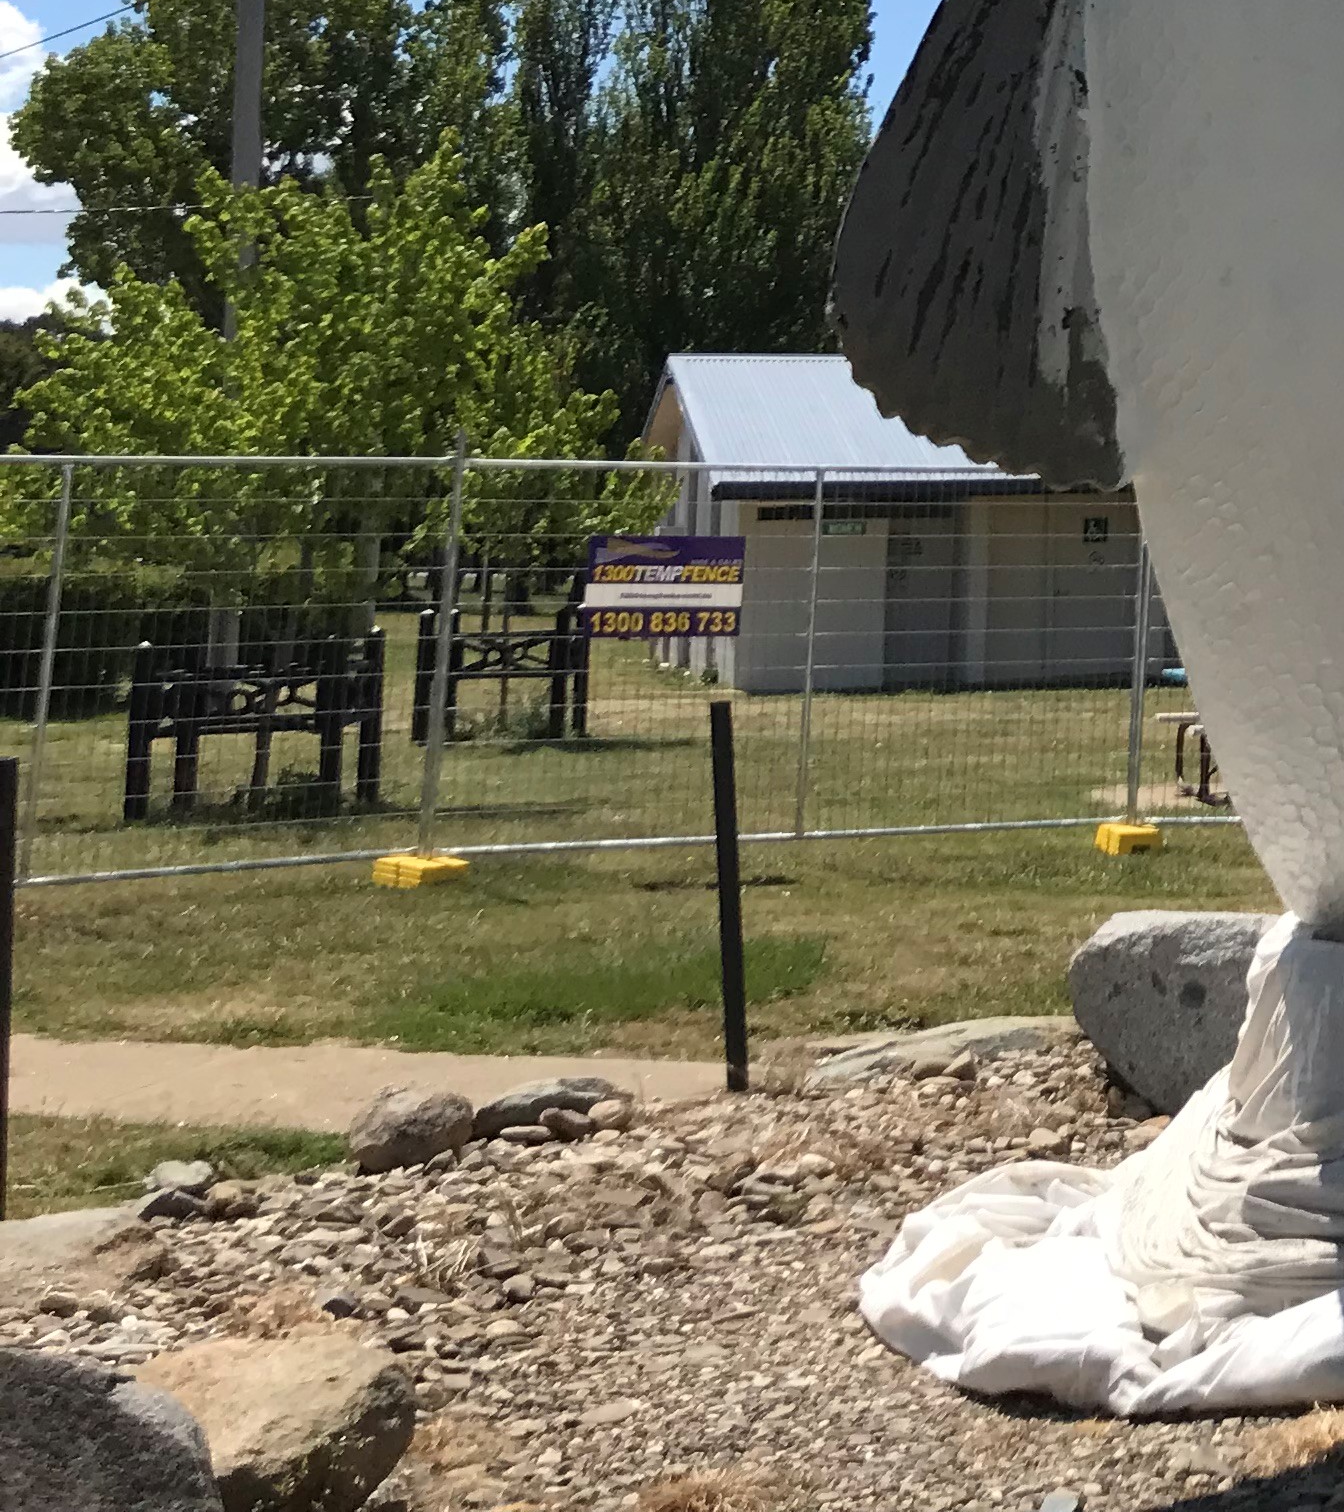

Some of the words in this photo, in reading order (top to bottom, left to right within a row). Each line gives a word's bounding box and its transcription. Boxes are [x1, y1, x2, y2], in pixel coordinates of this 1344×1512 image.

[592, 565, 741, 582] 1300TEMPFENCE
[590, 611, 644, 633] 1300
[650, 611, 691, 633] 836
[696, 611, 736, 633] 733
